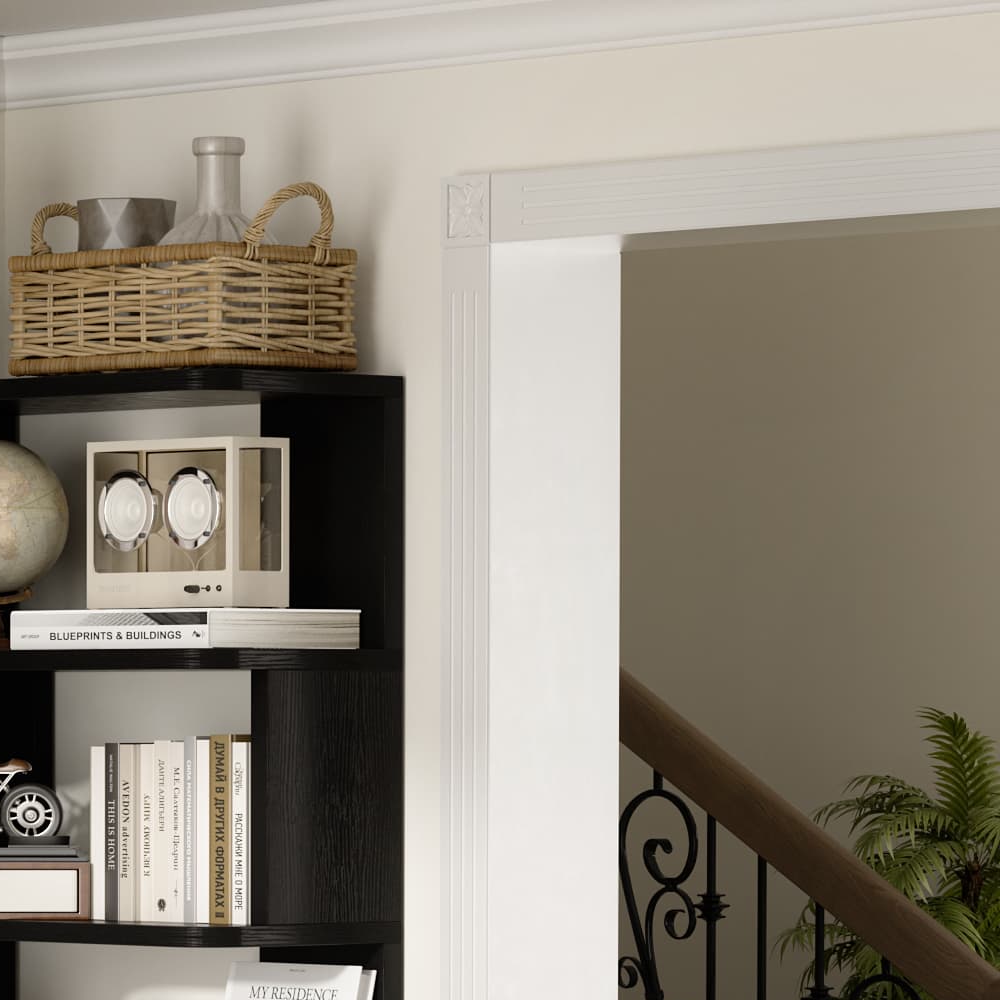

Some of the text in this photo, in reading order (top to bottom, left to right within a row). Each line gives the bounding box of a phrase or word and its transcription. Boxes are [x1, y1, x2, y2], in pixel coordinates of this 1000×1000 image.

[50, 631, 113, 641] BLUEPRINTS
[116, 632, 123, 641] &
[126, 631, 183, 641] BUILDINGS
[214, 741, 227, 782] ДУМАЙ
[108, 800, 116, 824] THIS
[214, 797, 225, 843] ДРУГИХ
[108, 827, 116, 836] IS
[121, 780, 130, 879] AVEDON advertising
[234, 813, 244, 857] РАССКАЖИ
[108, 838, 116, 871] HOME
[234, 860, 244, 877] МНЕ
[214, 846, 225, 907] ФОРМАТАХ
[234, 888, 244, 911] МОРЕ
[249, 985, 269, 999] MY
